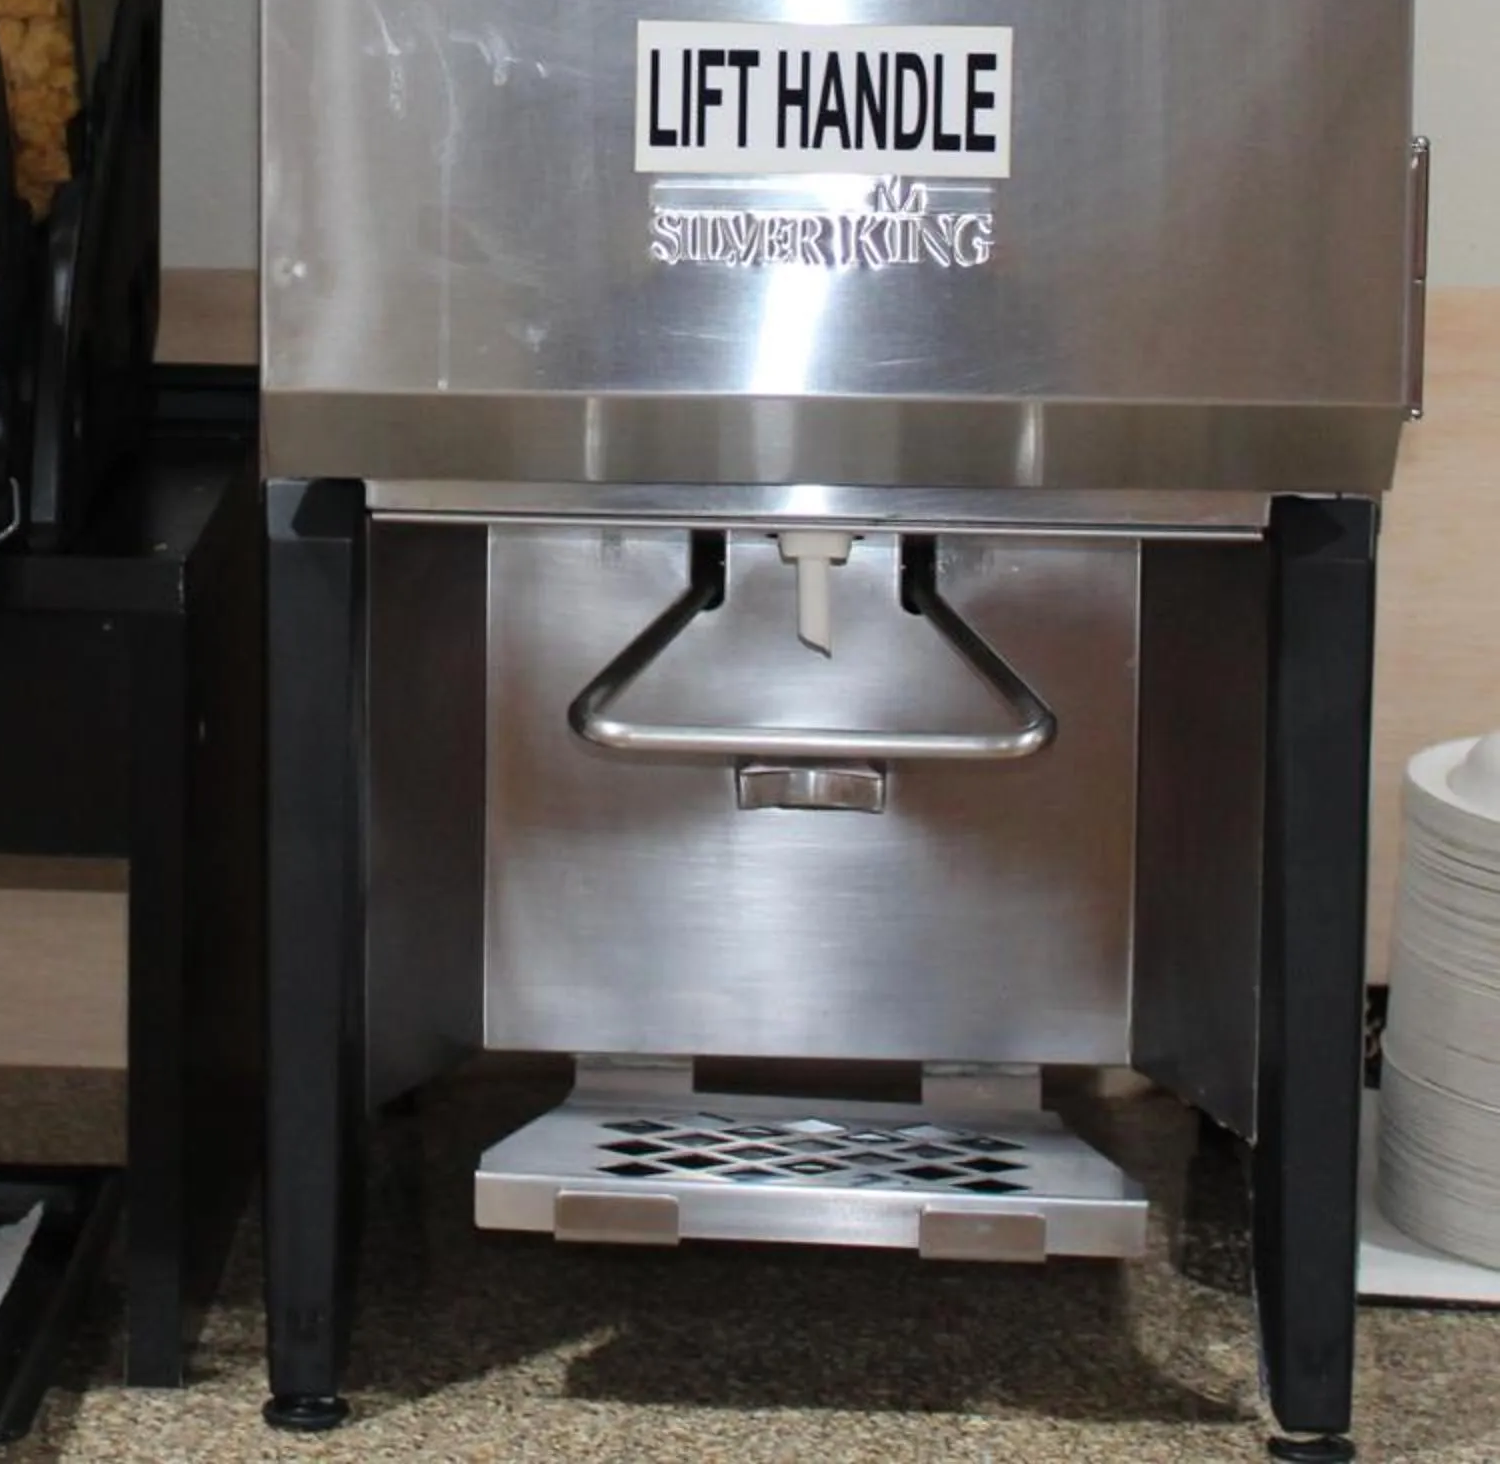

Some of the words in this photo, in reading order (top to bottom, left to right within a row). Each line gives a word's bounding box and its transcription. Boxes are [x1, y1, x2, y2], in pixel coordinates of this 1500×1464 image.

[649, 49, 760, 148] LIFT
[776, 50, 997, 153] HANDLE
[651, 209, 830, 267] SILVER
[843, 211, 995, 269] KING
